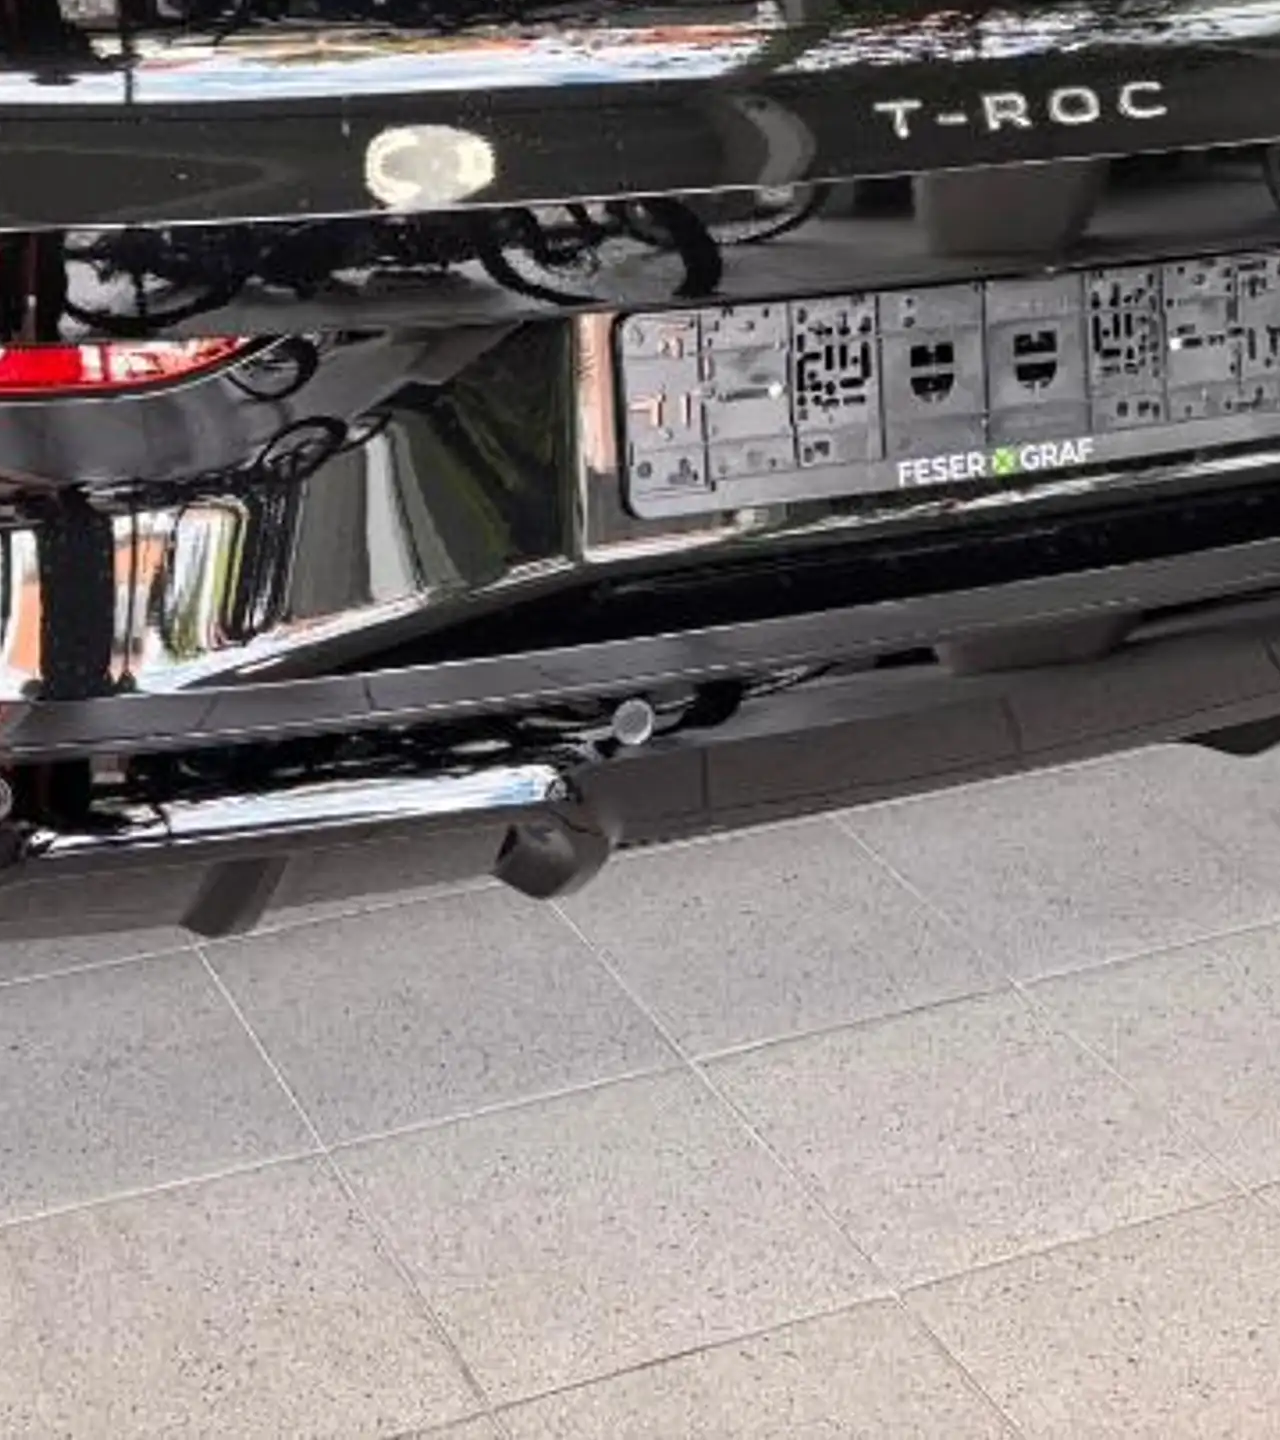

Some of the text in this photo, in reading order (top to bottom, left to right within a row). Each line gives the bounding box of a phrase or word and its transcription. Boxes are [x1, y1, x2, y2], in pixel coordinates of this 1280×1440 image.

[873, 81, 1168, 139] T-ROC
[896, 437, 1094, 489] FESER GRAF
